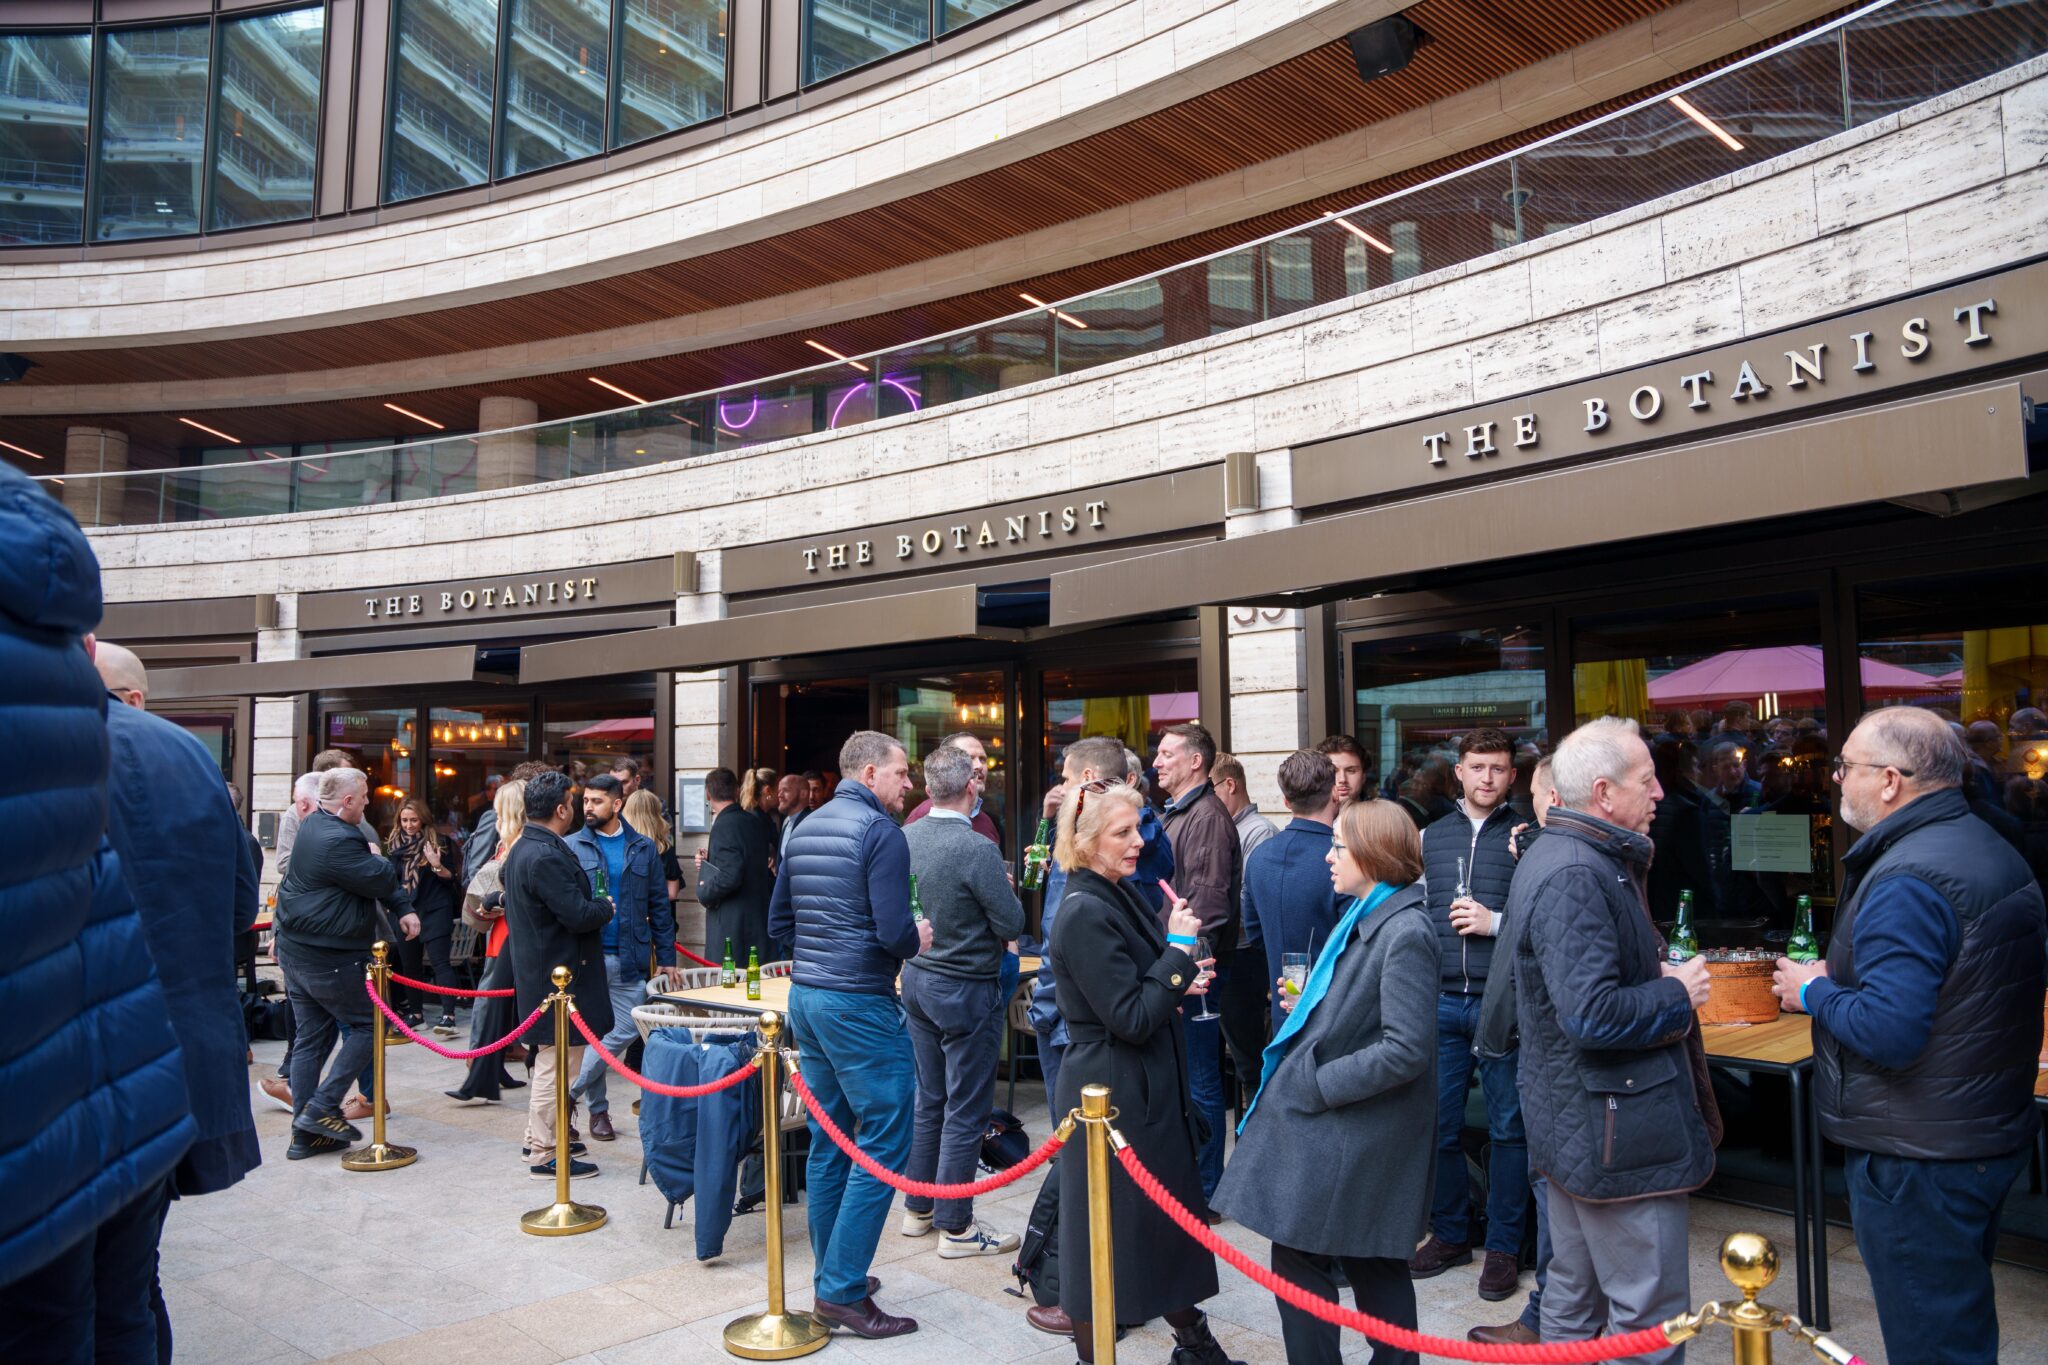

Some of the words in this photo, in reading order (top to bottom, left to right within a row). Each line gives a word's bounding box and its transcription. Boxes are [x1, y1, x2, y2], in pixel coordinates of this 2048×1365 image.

[1422, 413, 1538, 465] THE
[1583, 299, 1997, 432] BOTANIST
[803, 541, 872, 571] THE
[896, 501, 1106, 557] BOTANIST
[366, 595, 421, 616] THE
[440, 578, 597, 610] BOTANIST
